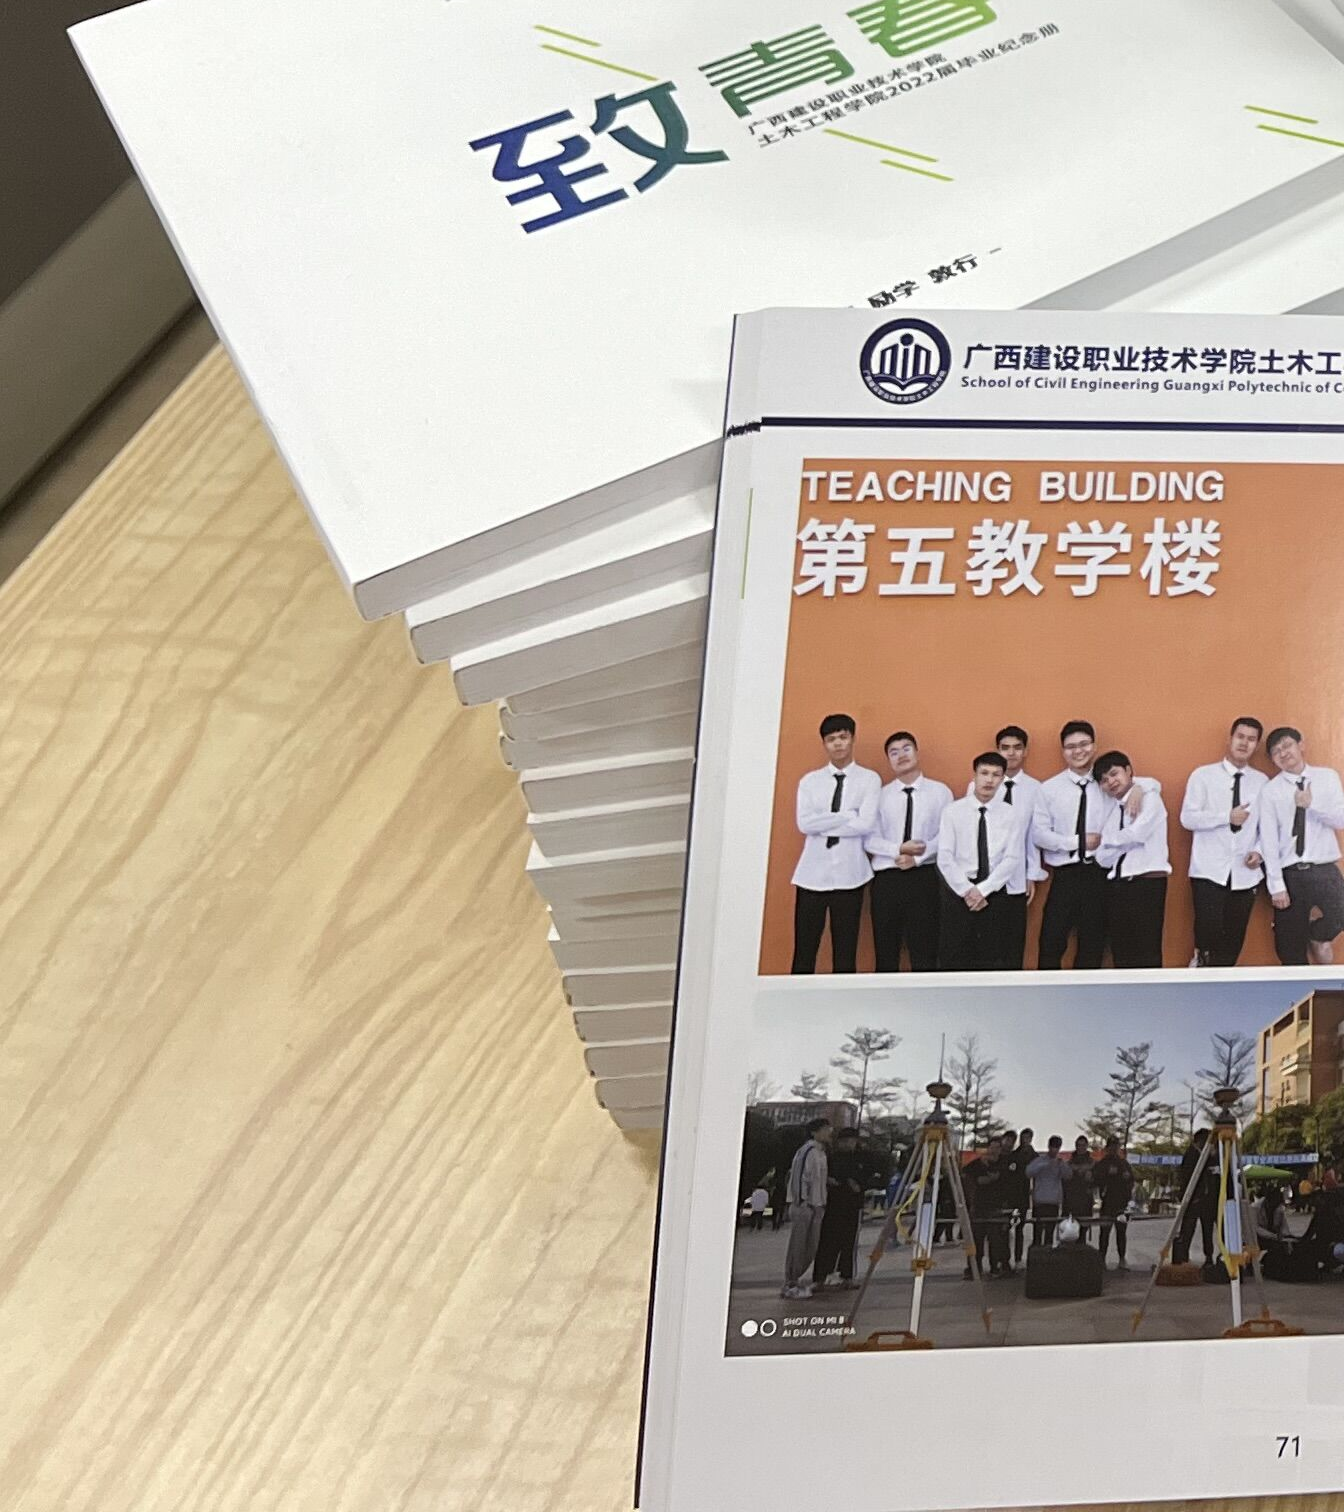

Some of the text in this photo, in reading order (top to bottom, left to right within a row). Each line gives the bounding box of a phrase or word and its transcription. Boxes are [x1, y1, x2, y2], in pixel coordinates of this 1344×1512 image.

[747, 52, 948, 137] 广西建设职业技术学院
[960, 375, 1012, 389] School
[1015, 375, 1032, 389] of
[1034, 376, 1066, 389] Civil
[1070, 377, 1160, 394] Engineering
[1163, 379, 1225, 395] Guangxi
[1228, 380, 1312, 396] Polytechnic
[1315, 381, 1331, 394] of
[802, 471, 1225, 503] TEACHING BUILDING
[792, 517, 1222, 598] 第五教学楼
[1274, 1435, 1301, 1460] 71
